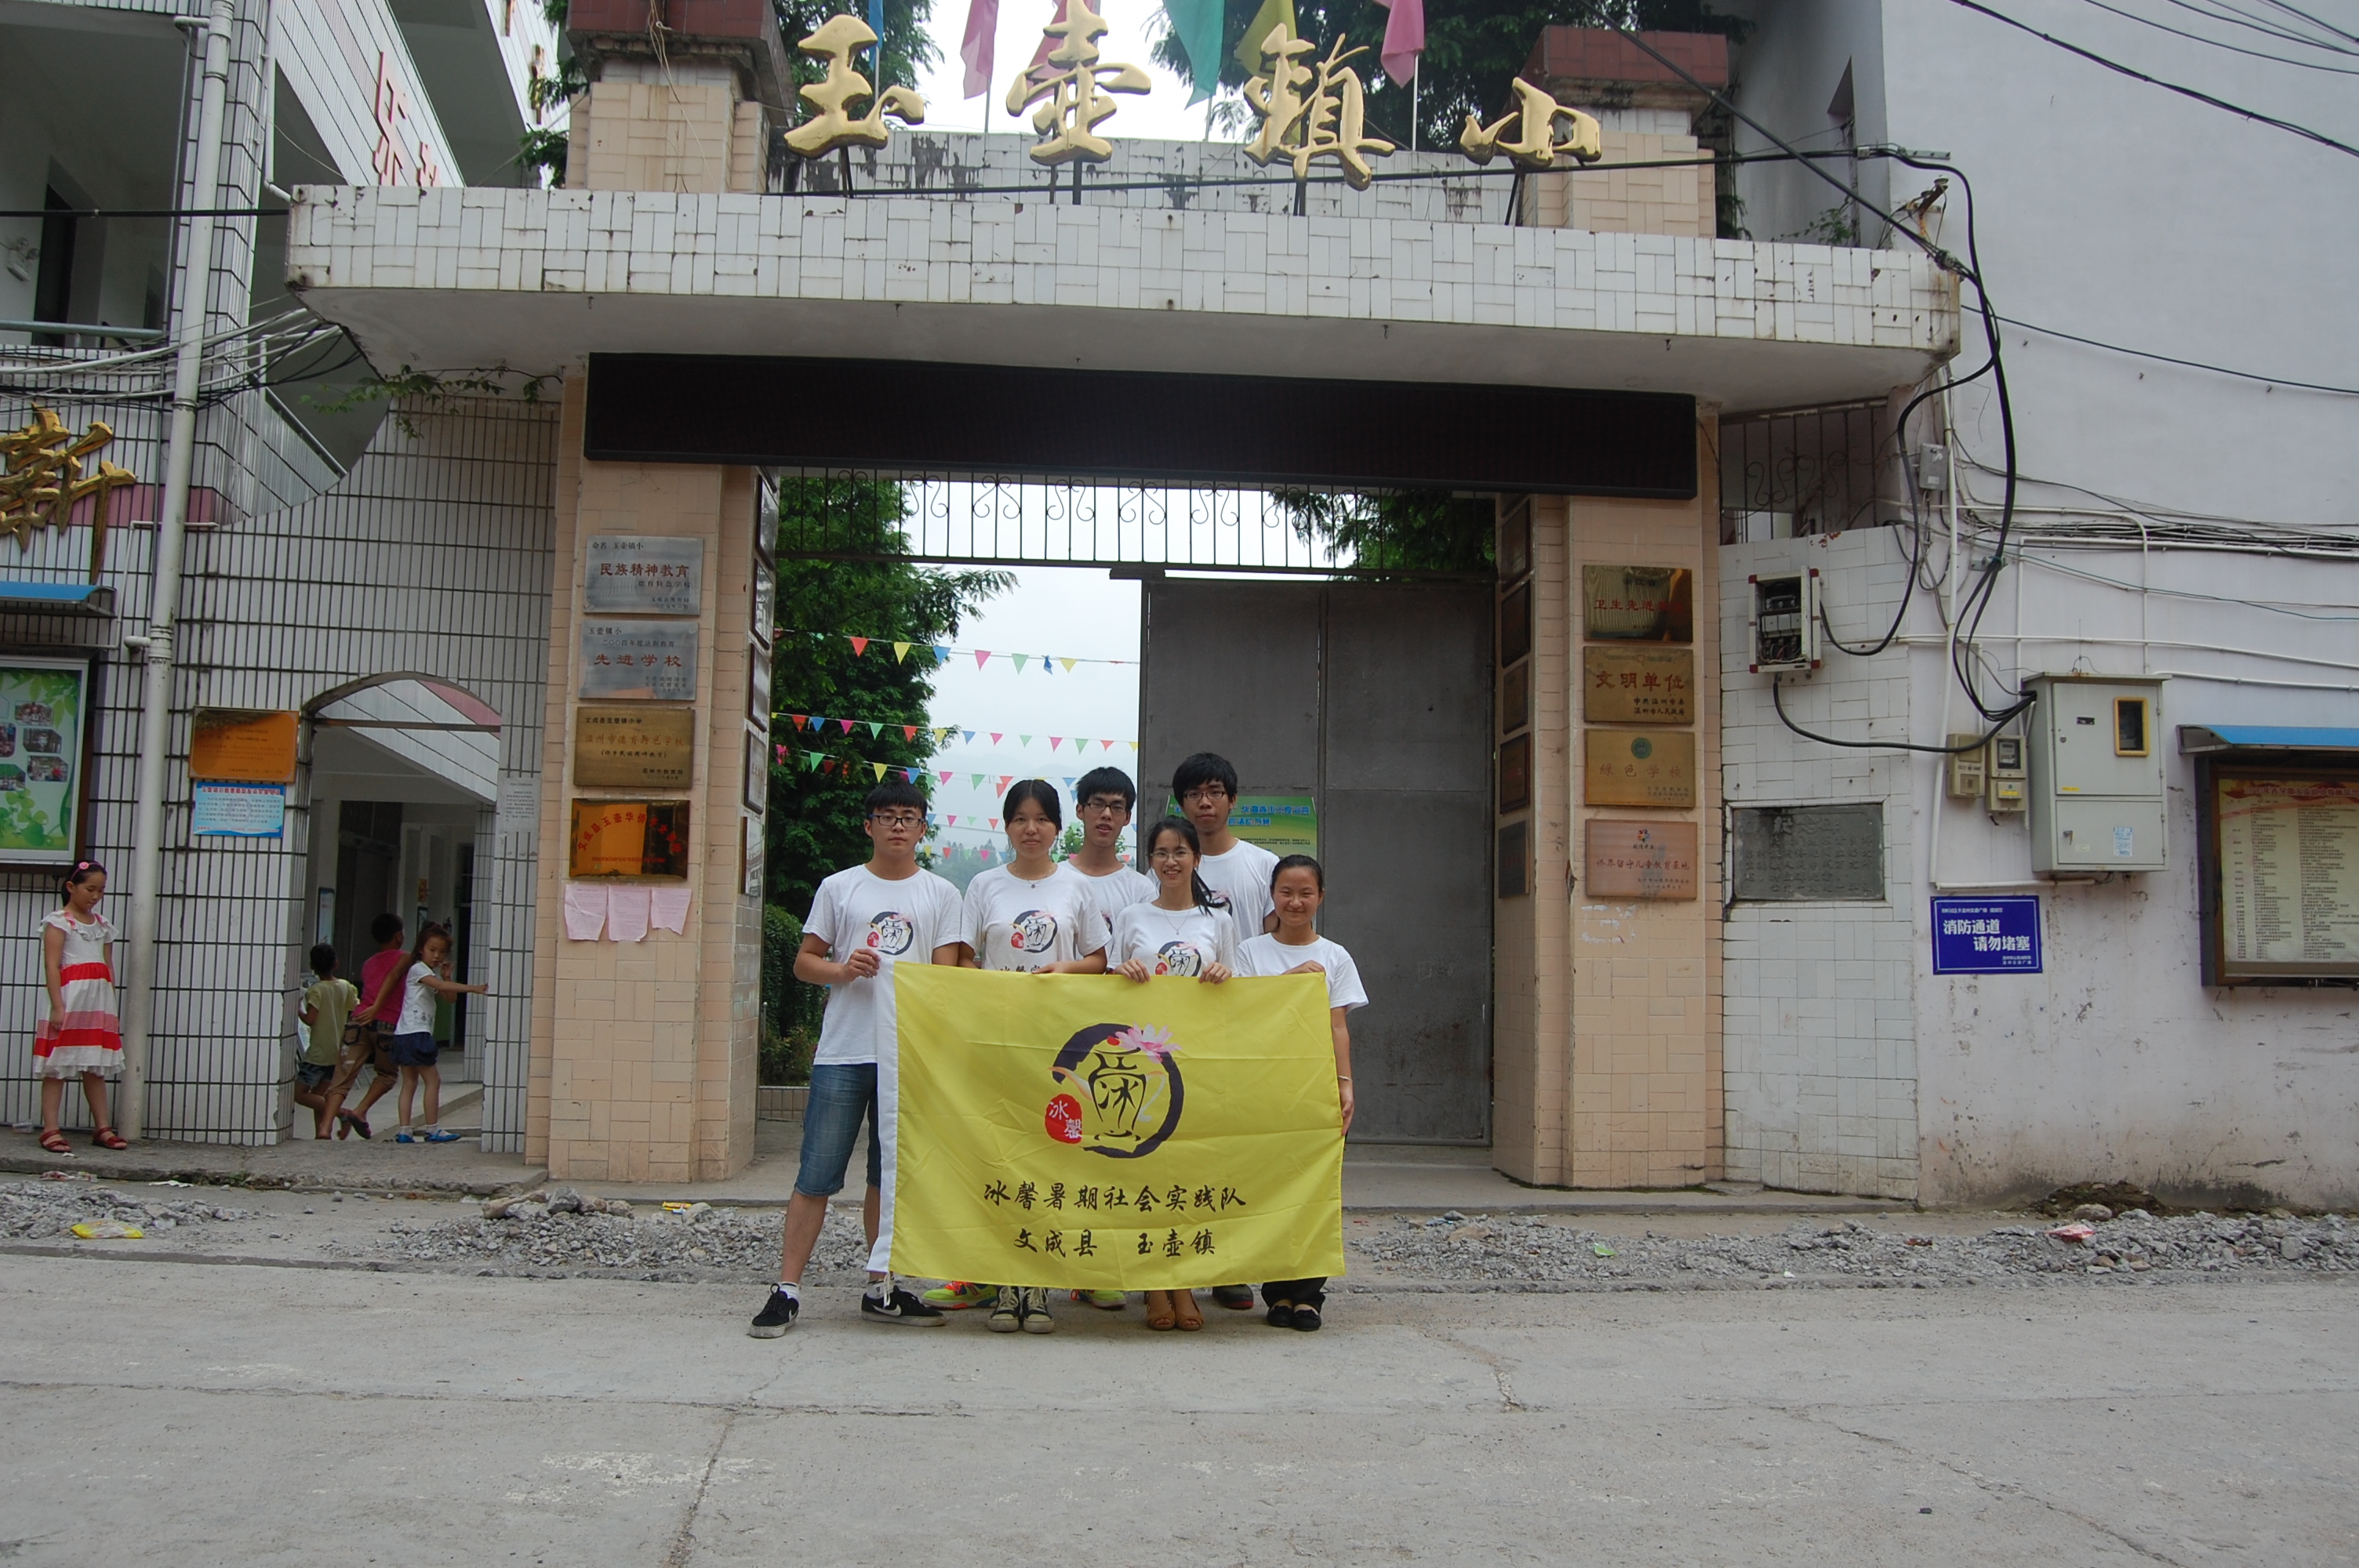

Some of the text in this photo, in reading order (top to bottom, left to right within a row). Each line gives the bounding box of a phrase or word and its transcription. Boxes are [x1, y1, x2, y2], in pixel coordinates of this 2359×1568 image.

[613, 542, 644, 550] 玉壶镇小
[600, 563, 689, 578] 民族精神教育
[594, 653, 682, 667] 先进学校
[1596, 670, 1685, 691] 文明单位
[1634, 707, 1685, 716] 温州市人民政府
[1943, 919, 2001, 935] 消防通道
[1973, 935, 2030, 952] 请勿堵塞
[983, 1180, 1246, 1213] 冰馨暑期社会实践队
[1014, 1228, 1216, 1258] 文成县 玉壶镇
